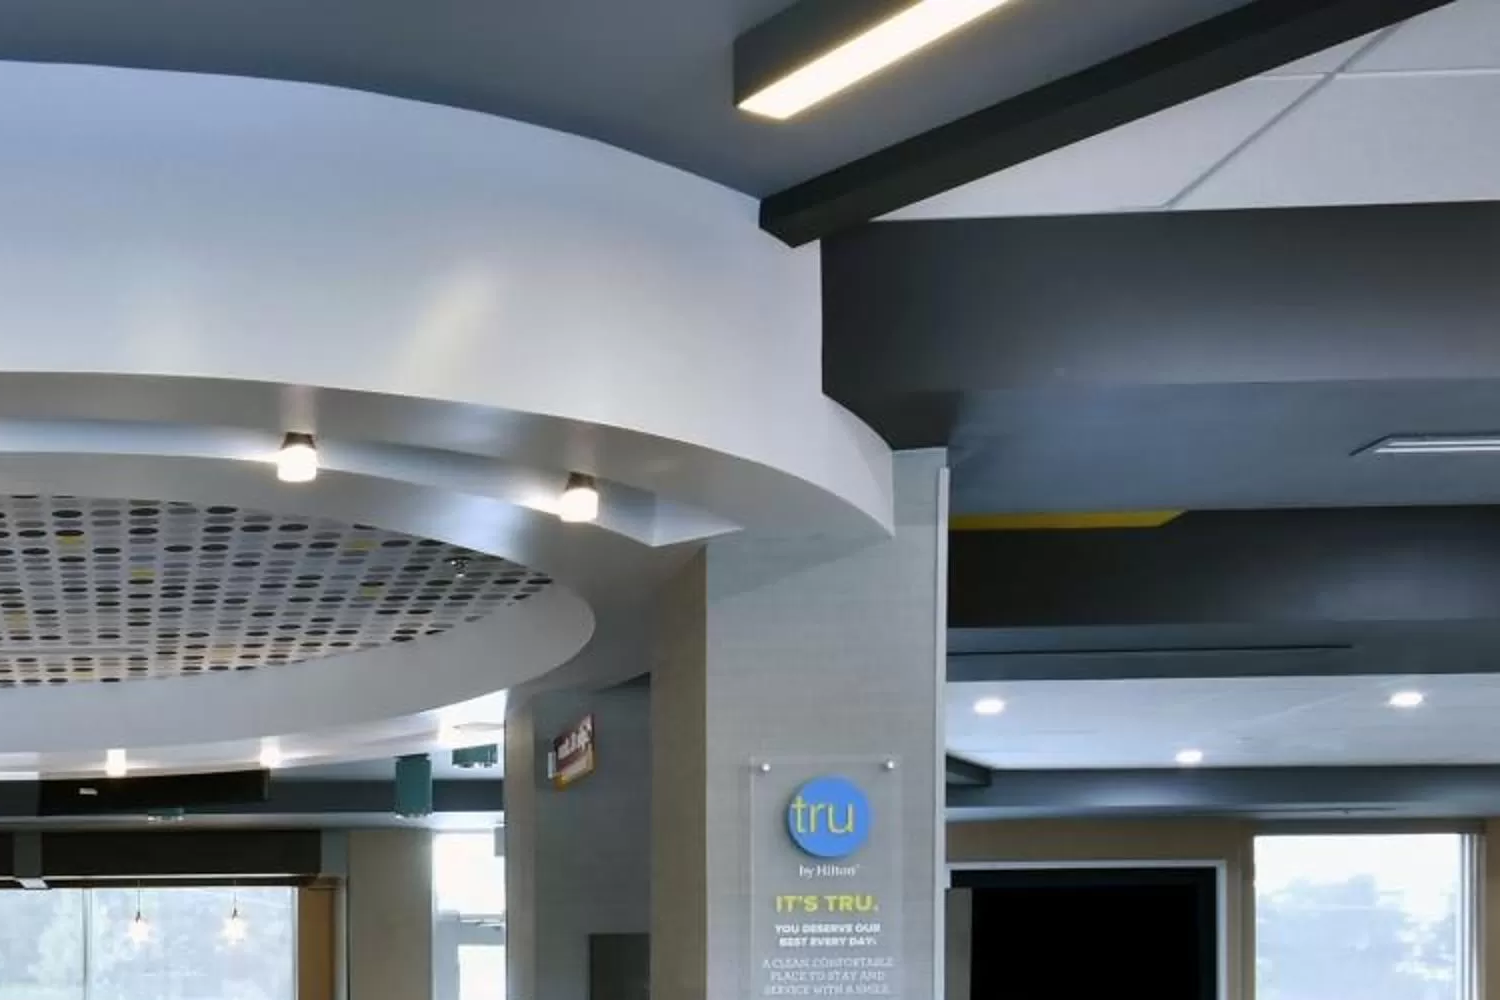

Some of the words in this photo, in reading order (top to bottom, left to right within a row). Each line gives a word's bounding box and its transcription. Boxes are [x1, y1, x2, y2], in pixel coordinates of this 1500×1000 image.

[791, 796, 854, 834] tru
[799, 863, 814, 880] by
[816, 863, 857, 877] Hilton
[775, 894, 819, 913] IT'S
[823, 894, 880, 913] TRU.
[775, 923, 800, 933] YOU
